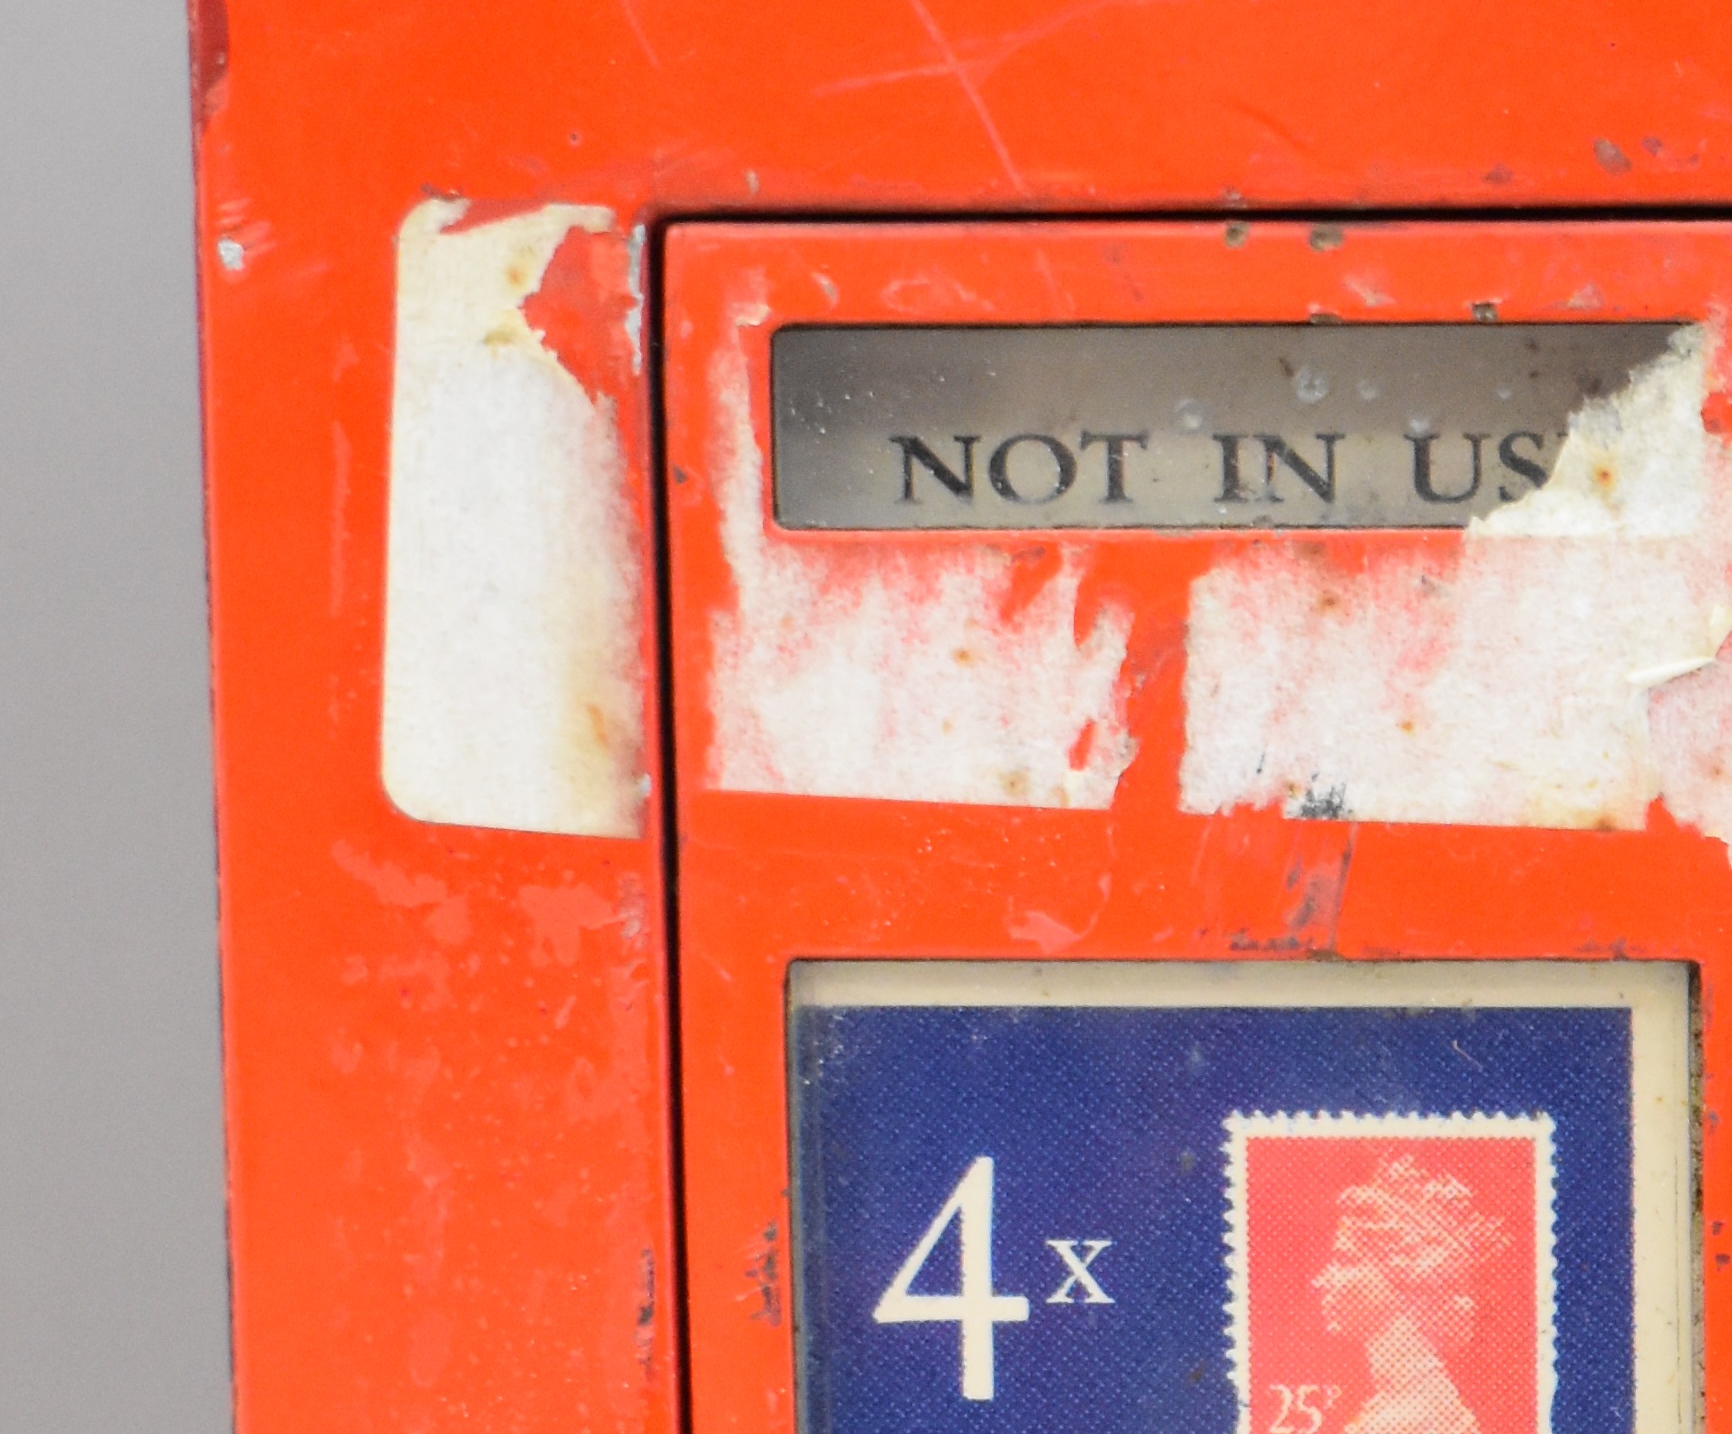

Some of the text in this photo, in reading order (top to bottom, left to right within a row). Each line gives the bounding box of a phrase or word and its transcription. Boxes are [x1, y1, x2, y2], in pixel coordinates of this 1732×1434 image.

[888, 430, 1569, 506] NOT IN US
